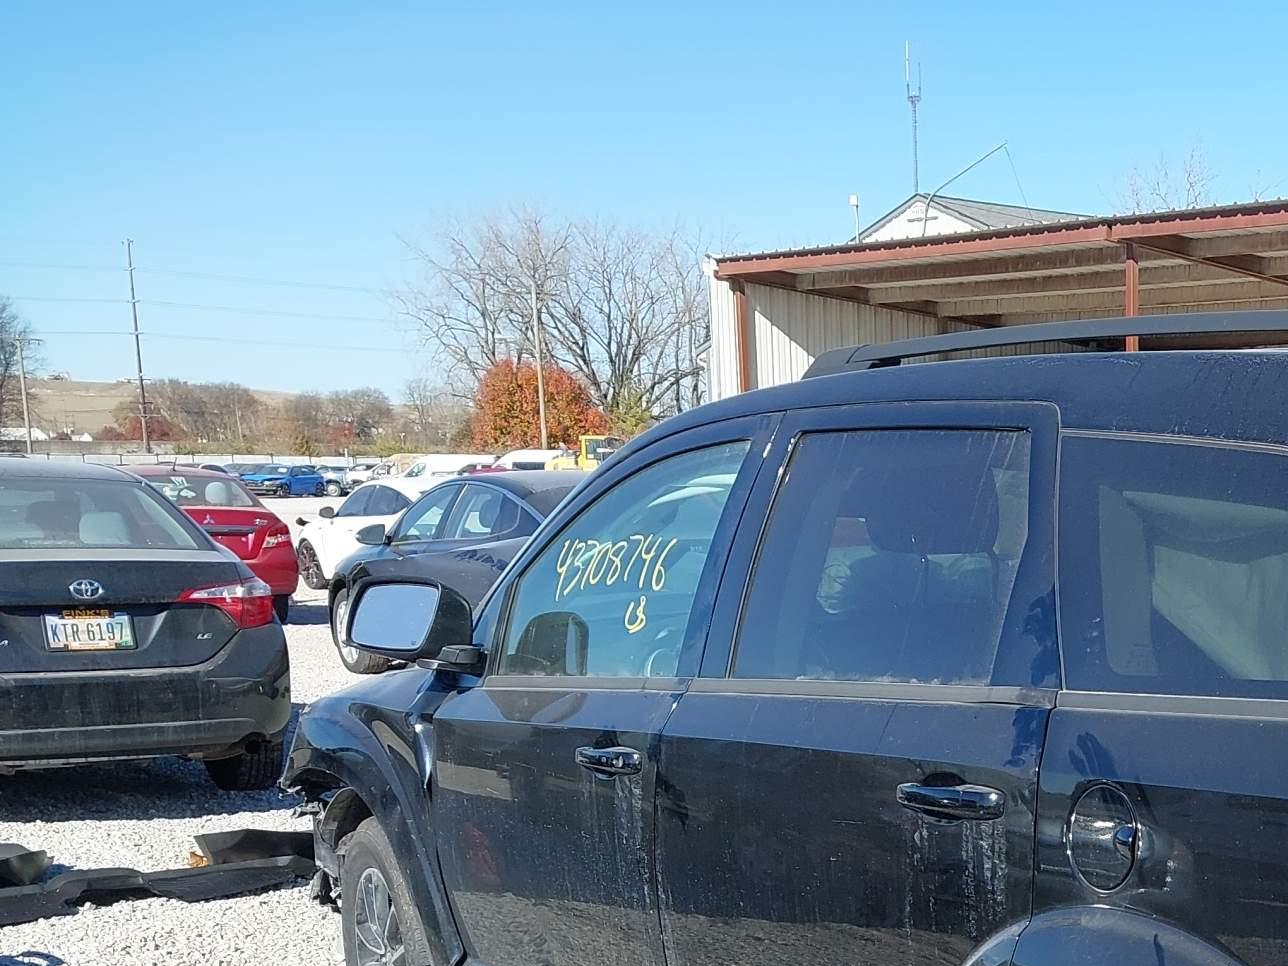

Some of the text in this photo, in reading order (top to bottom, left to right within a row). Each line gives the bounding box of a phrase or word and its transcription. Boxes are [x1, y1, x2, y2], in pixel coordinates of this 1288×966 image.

[556, 533, 678, 601] 43708746
[51, 622, 123, 642] KTR 6197
[196, 632, 213, 640] LE
